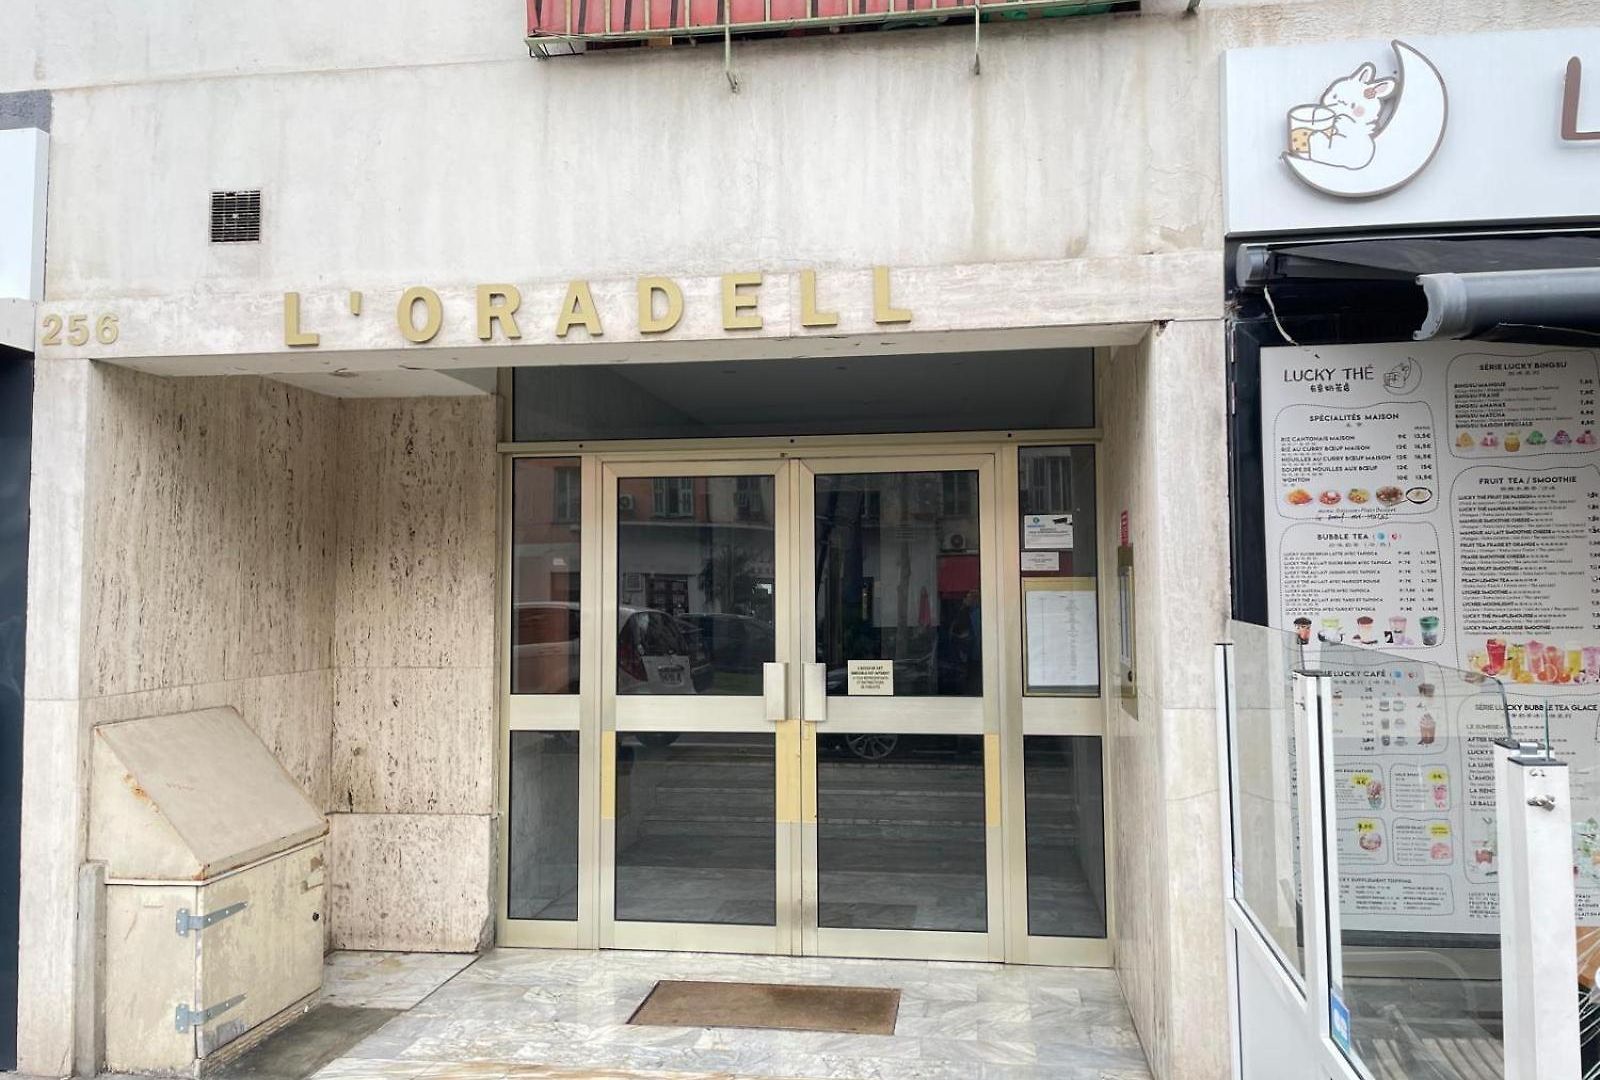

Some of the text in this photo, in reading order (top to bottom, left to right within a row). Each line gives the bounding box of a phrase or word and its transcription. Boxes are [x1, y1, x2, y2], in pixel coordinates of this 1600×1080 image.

[284, 266, 912, 347] L'ORADELL
[41, 312, 120, 346] 256
[1284, 365, 1374, 382] LUCKY THÉ
[1310, 413, 1361, 422] SPÉCIALITÉS
[1364, 669, 1385, 677] CAFÉ
